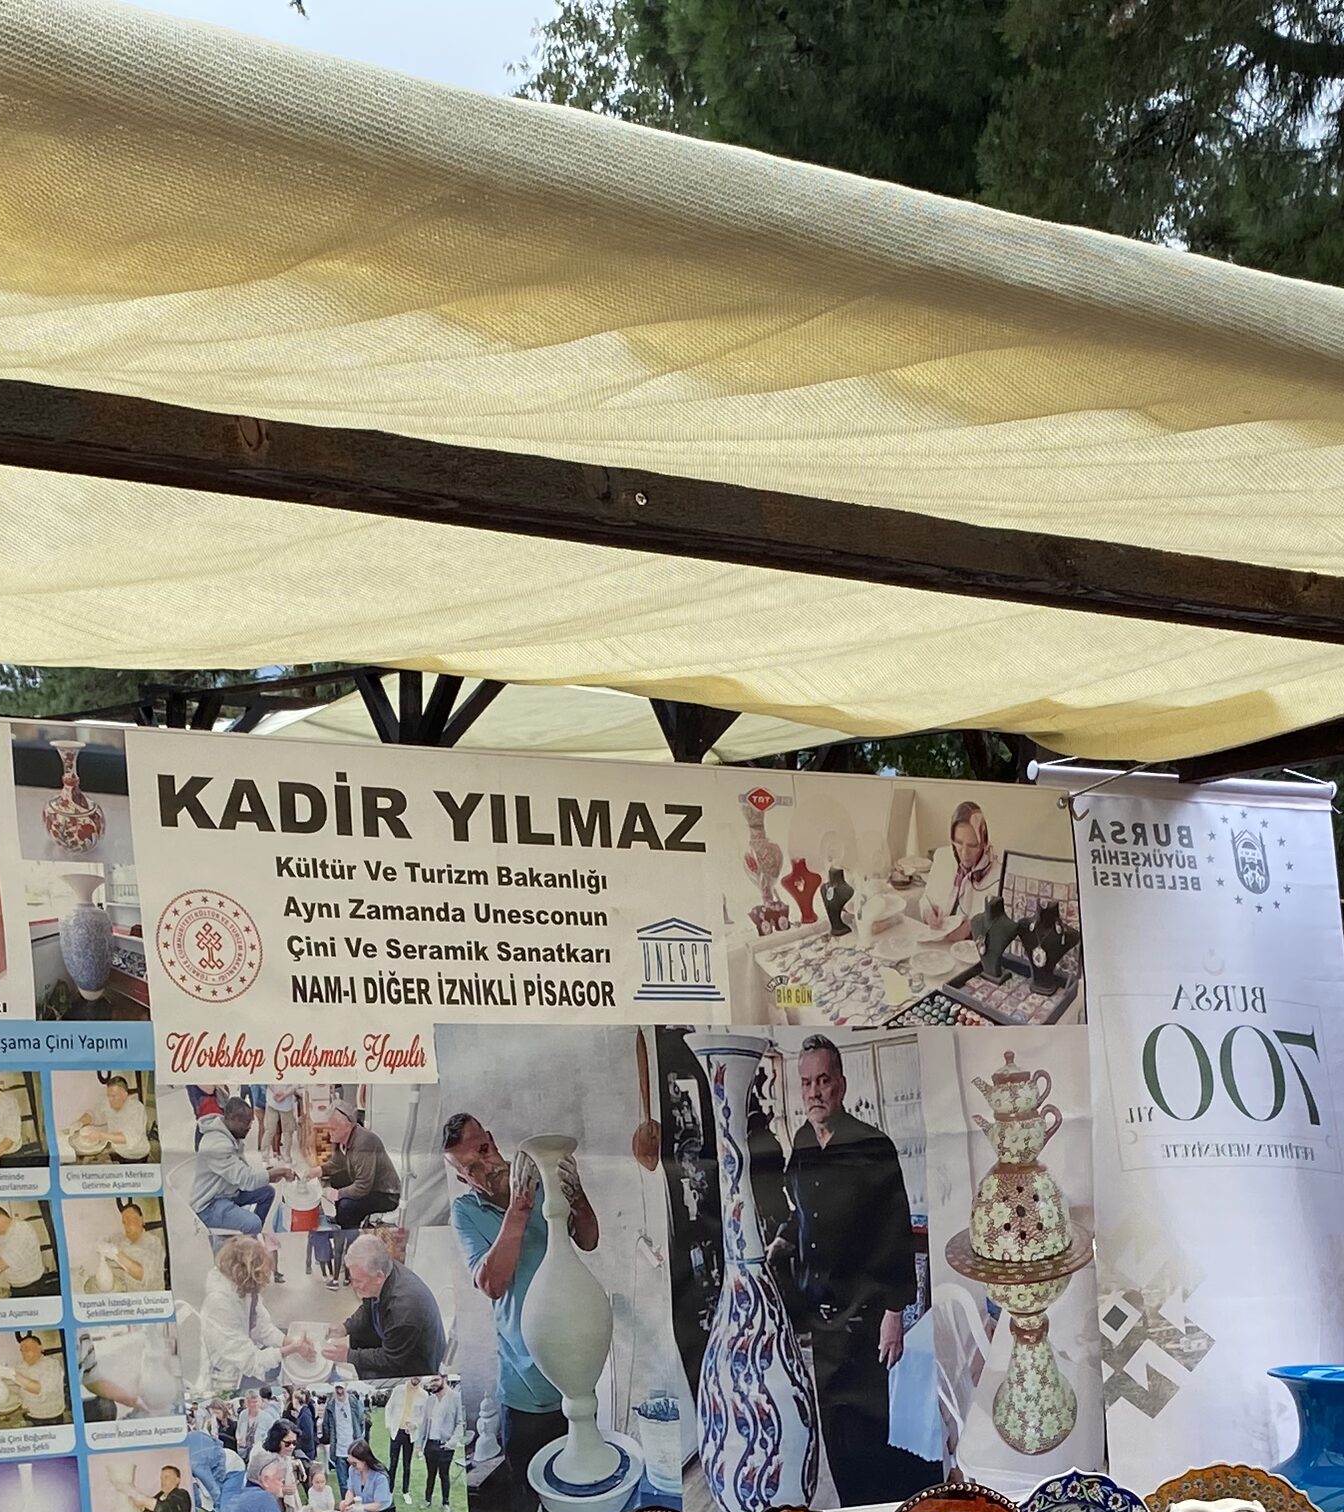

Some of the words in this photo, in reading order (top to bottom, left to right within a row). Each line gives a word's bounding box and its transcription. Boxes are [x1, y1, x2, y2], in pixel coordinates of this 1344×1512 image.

[156, 771, 412, 840] KADİR
[433, 789, 707, 853] YILMAZ
[751, 795, 771, 804] TRT
[275, 856, 356, 881] Kültür
[364, 860, 397, 882] Ve
[404, 862, 489, 886] Turizm
[497, 866, 607, 894] Bakanlığı
[283, 896, 340, 923] Aynı
[348, 898, 465, 923] Zamanda
[474, 903, 608, 927] Unesconun
[287, 935, 336, 962] Çini
[344, 937, 377, 959] Ve
[386, 938, 489, 962] Seramik
[497, 941, 611, 964] Sanatkarı
[642, 942, 711, 983] UNESCO
[291, 974, 356, 1004] NAM-I
[363, 970, 432, 1005] DİĞER
[437, 972, 517, 1006] İZNİKLİ
[524, 973, 616, 1007] PİSAGOR
[46, 1034, 74, 1053] Çini
[78, 1036, 128, 1054] Yapımı
[166, 1032, 265, 1074] Workshop
[274, 1033, 357, 1080] Çalışması
[363, 1034, 427, 1074] Yapılır
